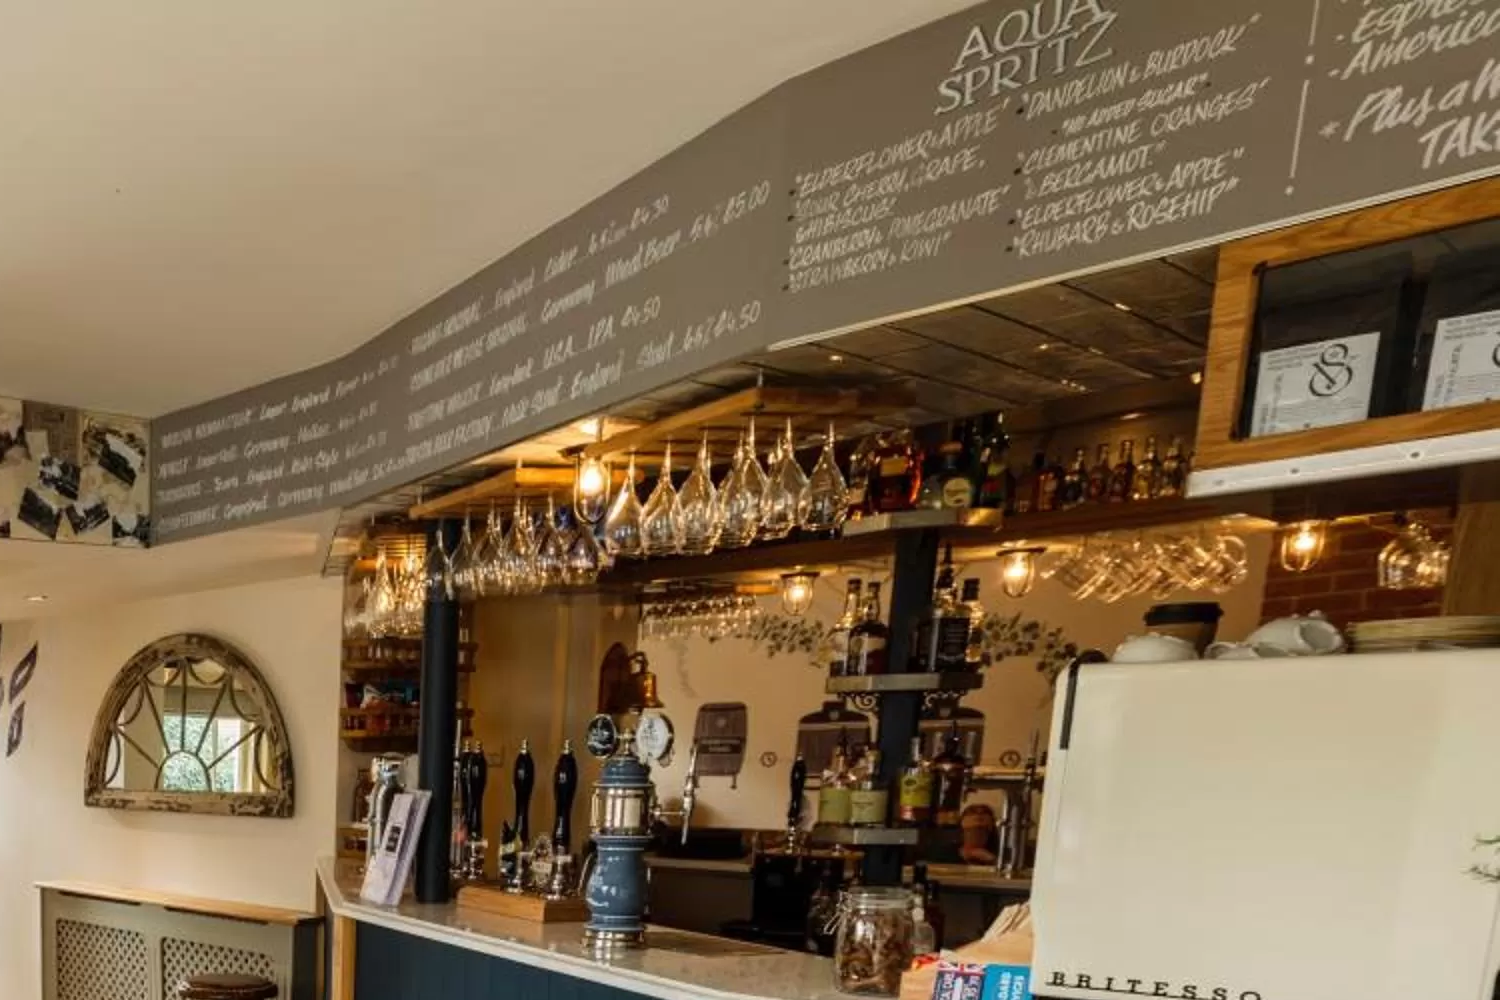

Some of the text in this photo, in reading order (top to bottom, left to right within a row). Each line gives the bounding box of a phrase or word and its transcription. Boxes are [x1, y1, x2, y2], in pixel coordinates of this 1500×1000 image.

[933, 11, 1119, 116] SPRITZ
[951, 0, 1104, 72] AQUA
[1343, 84, 1434, 142] Plus
